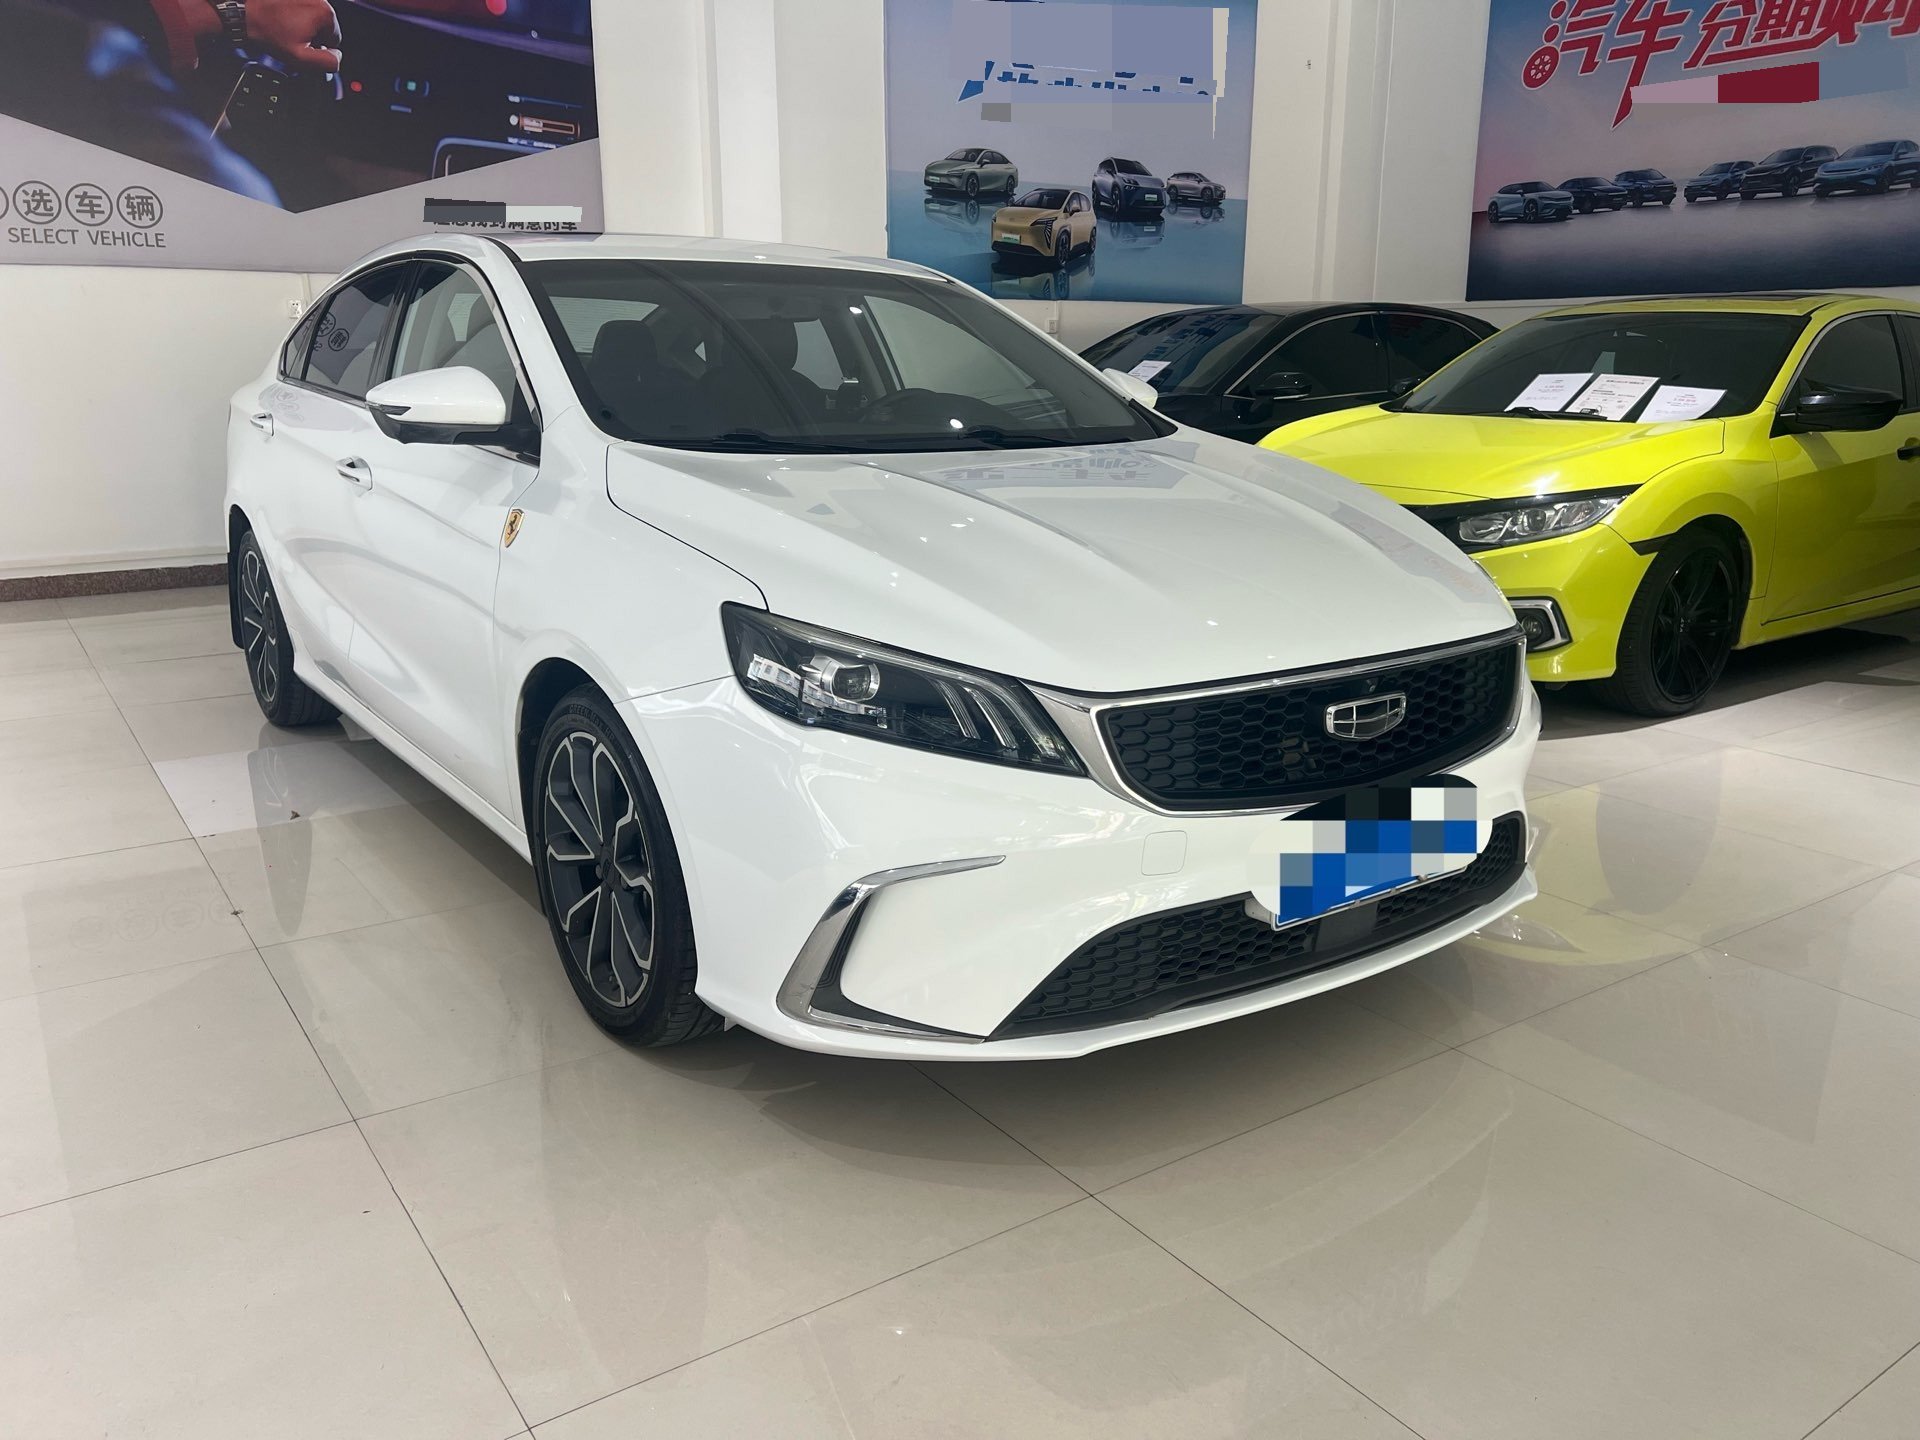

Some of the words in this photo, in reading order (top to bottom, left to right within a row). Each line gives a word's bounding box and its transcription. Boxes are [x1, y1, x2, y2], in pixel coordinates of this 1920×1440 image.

[20, 188, 157, 222] 选车辆
[8, 227, 79, 245] SELECT
[87, 229, 166, 248] VEHICLE
